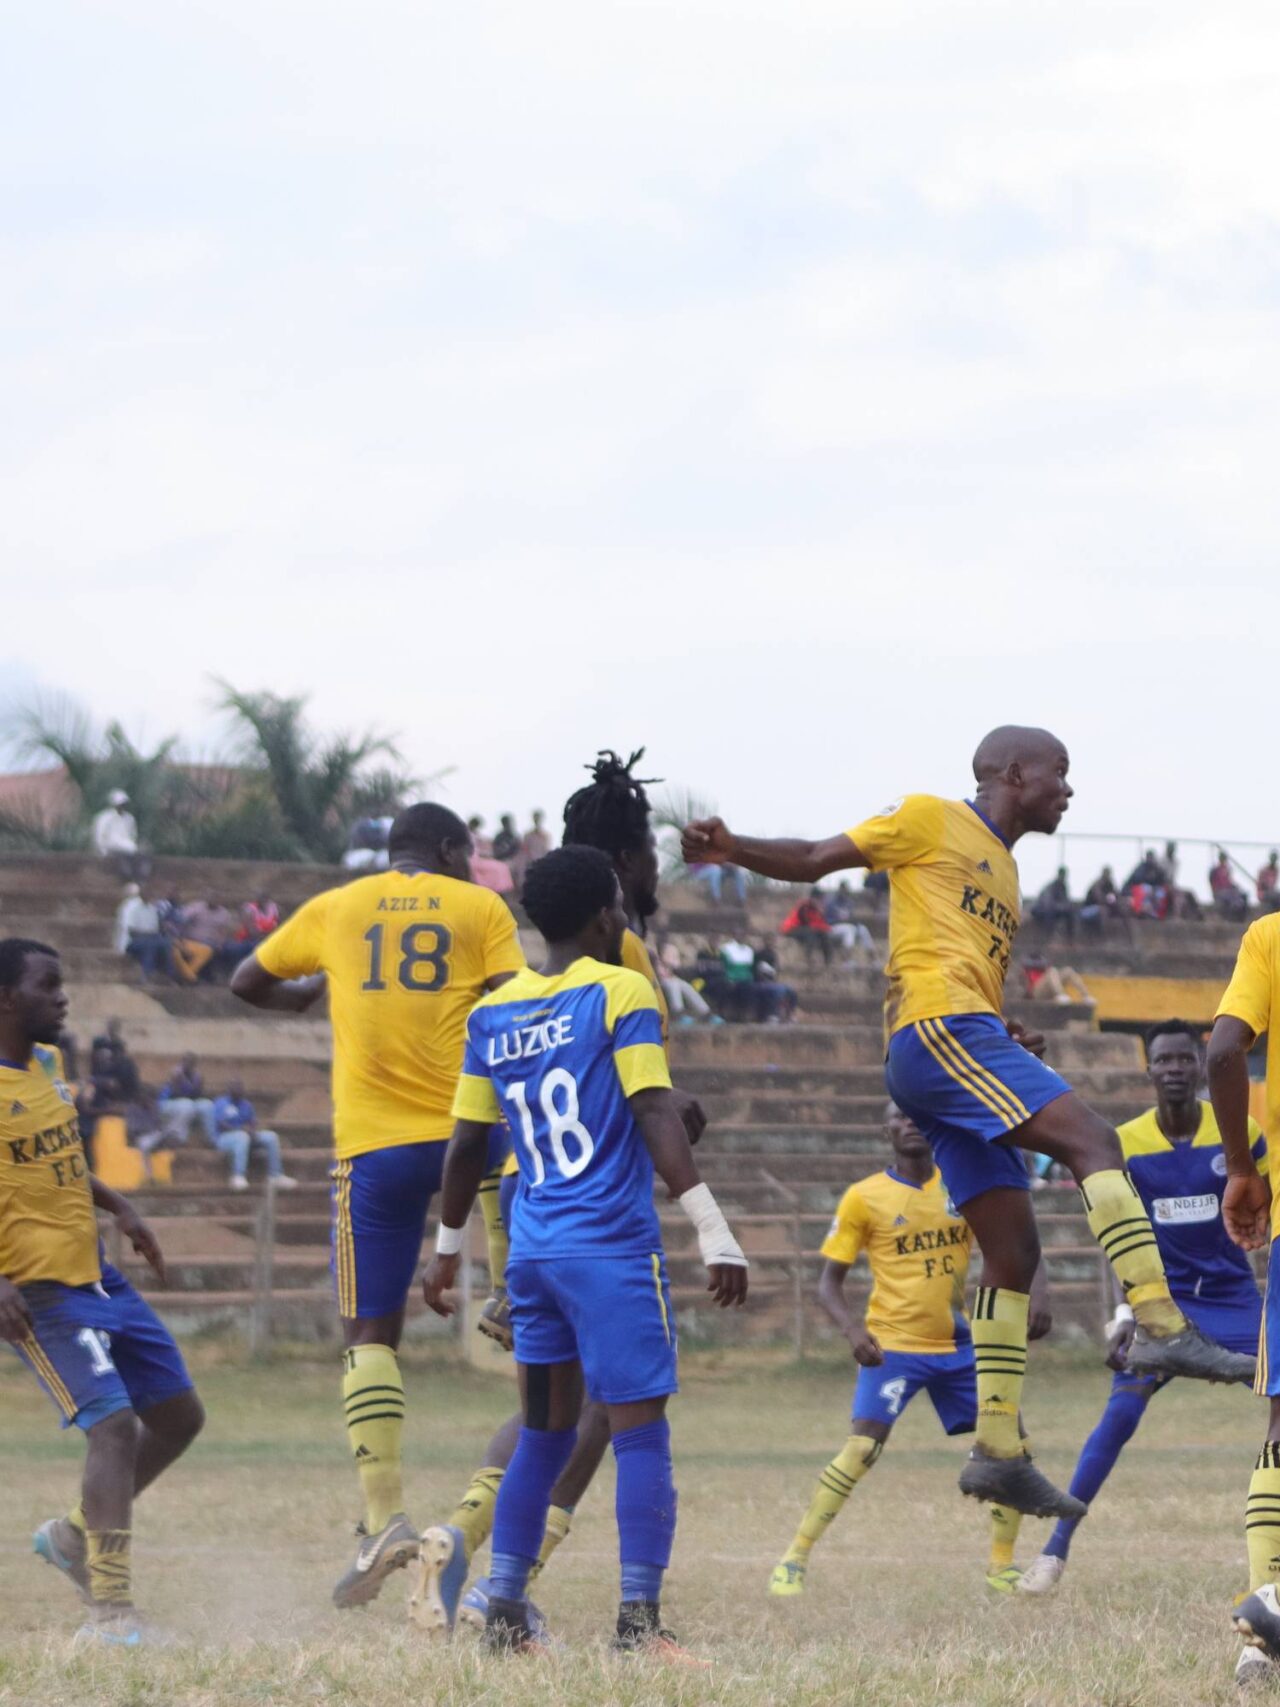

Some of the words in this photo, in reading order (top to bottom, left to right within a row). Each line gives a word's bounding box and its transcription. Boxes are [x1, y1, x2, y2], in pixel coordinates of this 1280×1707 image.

[428, 897, 441, 910] N
[362, 922, 453, 993] 18
[487, 1014, 576, 1067] LUZIGE
[505, 1067, 594, 1188] 18
[1173, 1195, 1216, 1209] NDEJJE
[895, 1225, 969, 1255] KATAKA
[925, 1255, 954, 1278] F.C
[879, 1376, 907, 1415] 4
